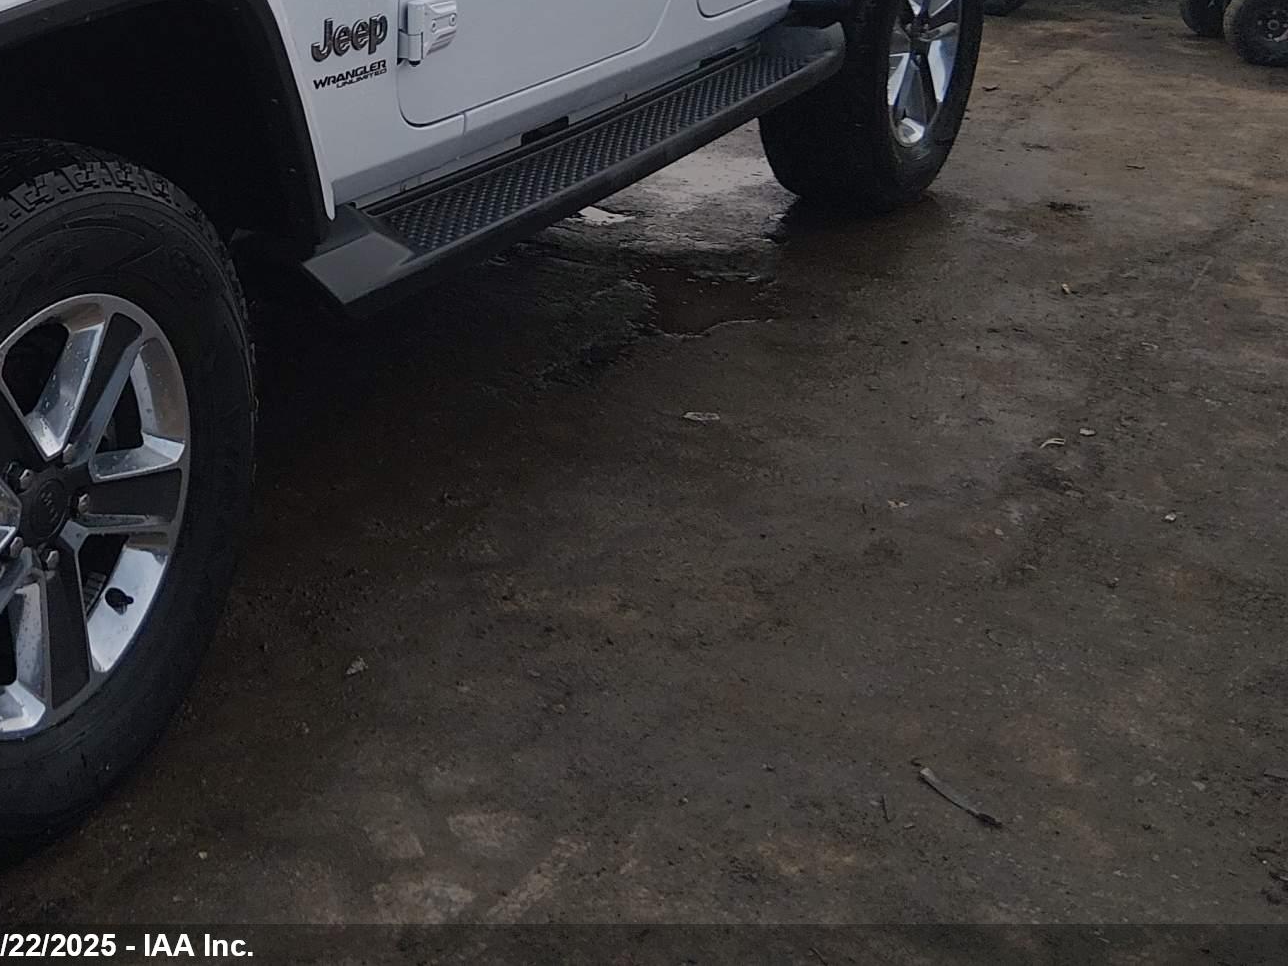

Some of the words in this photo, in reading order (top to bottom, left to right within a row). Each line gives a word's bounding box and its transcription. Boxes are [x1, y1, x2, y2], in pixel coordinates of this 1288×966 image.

[310, 13, 389, 63] Jeep
[313, 59, 387, 90] WRANGLER
[336, 68, 388, 89] UNLIMITED
